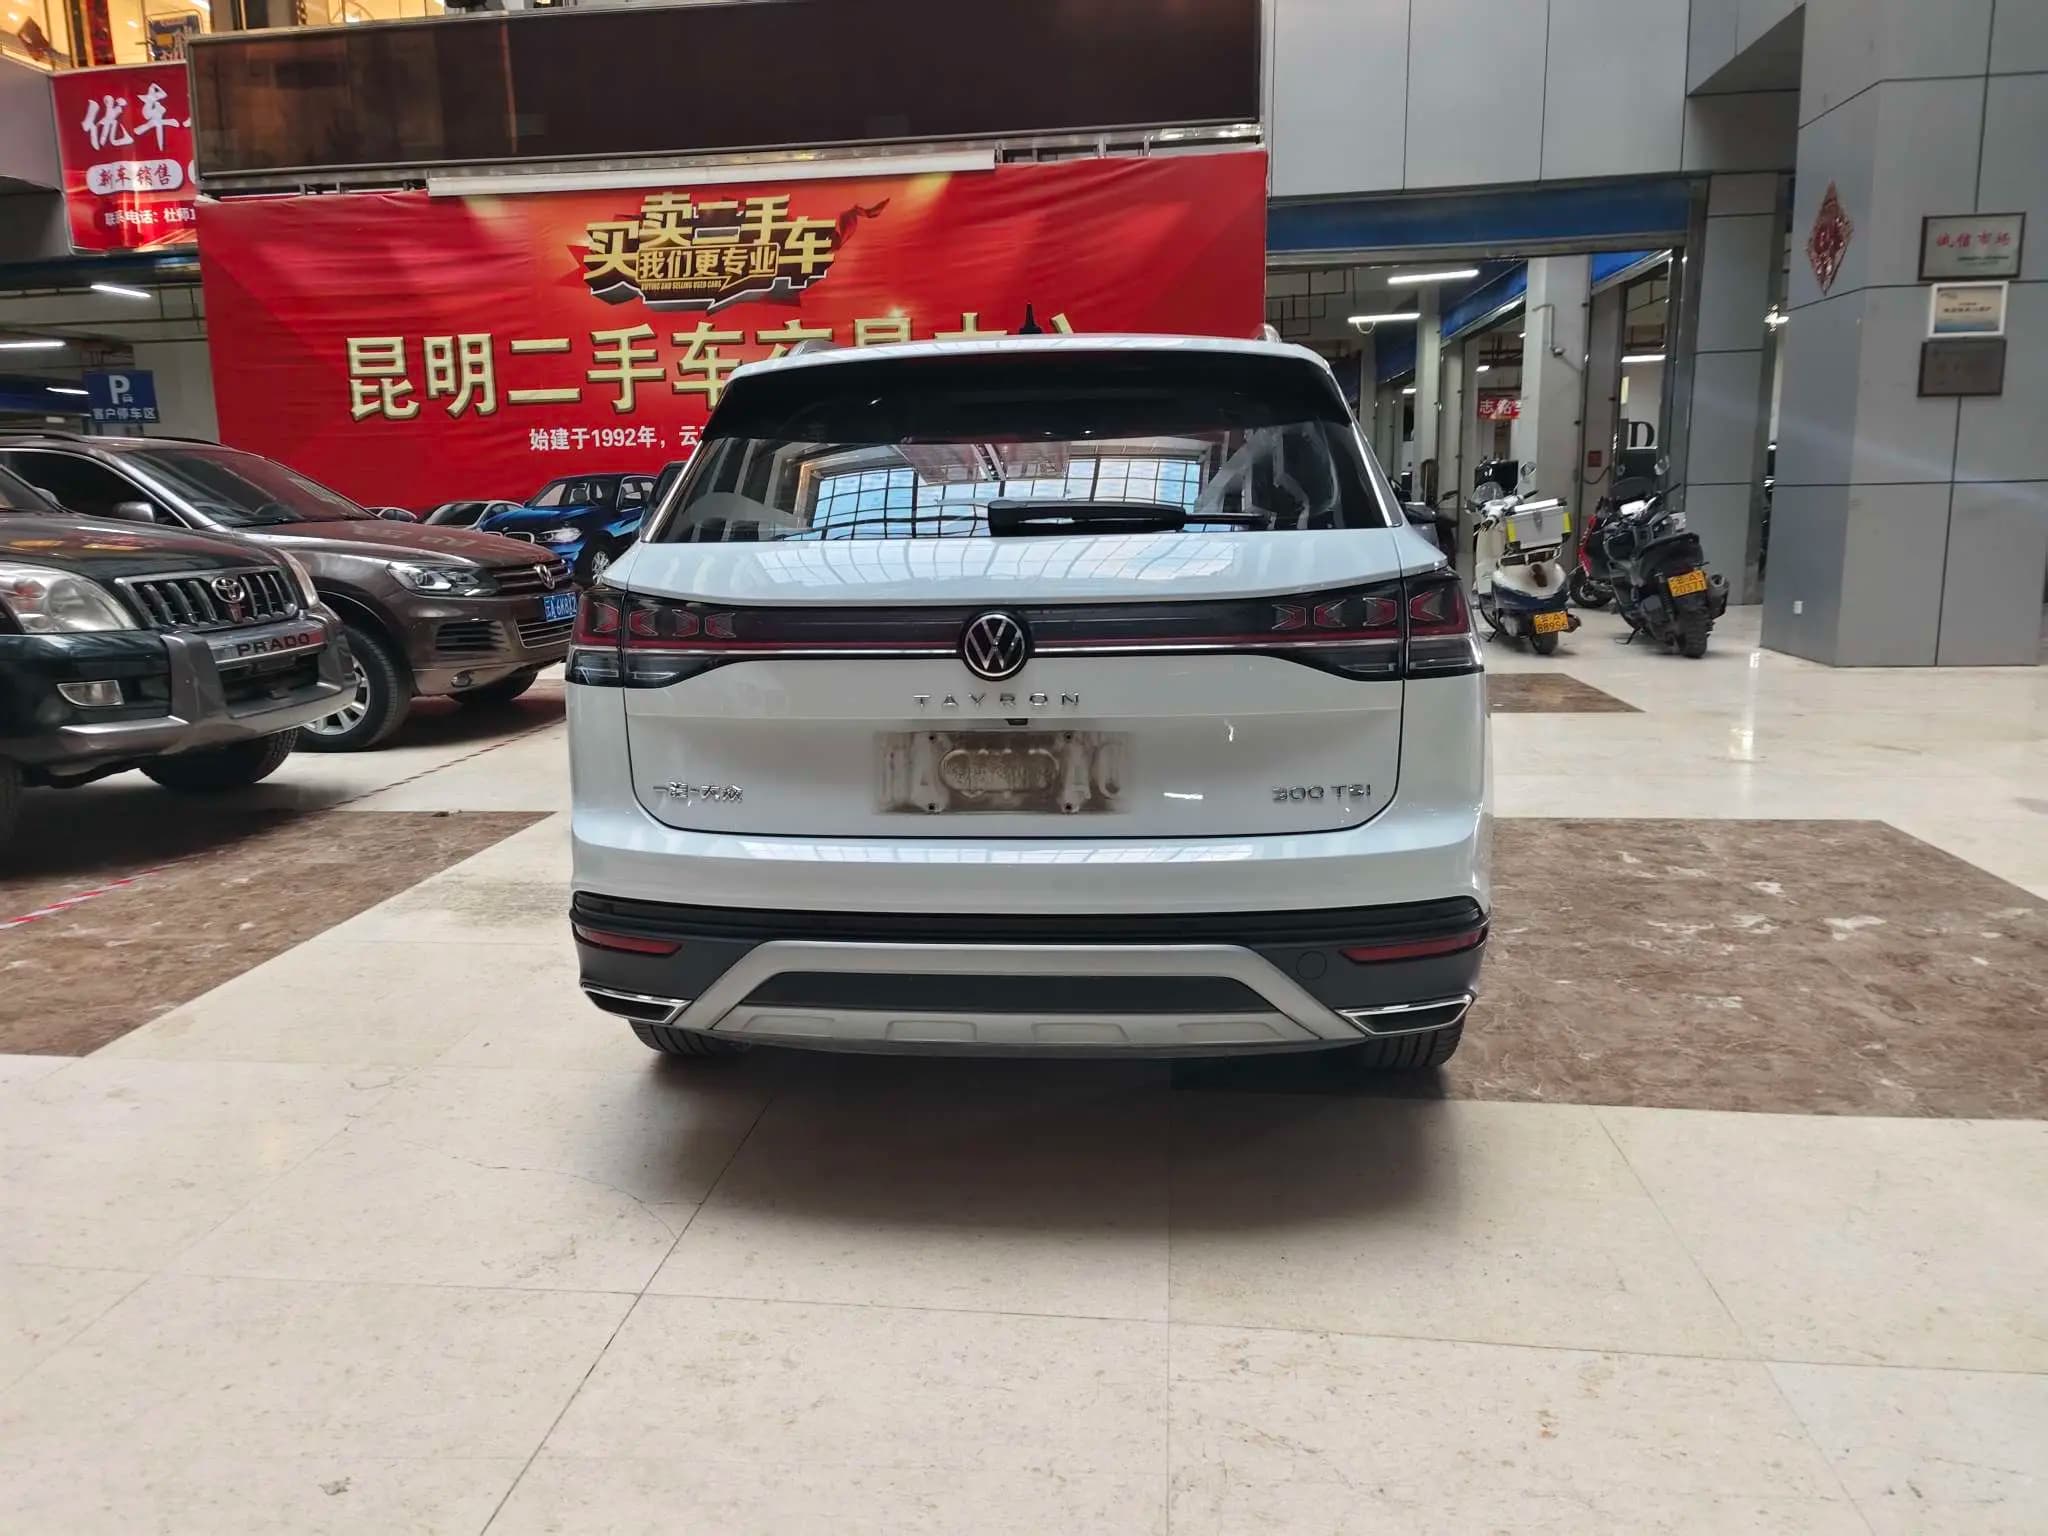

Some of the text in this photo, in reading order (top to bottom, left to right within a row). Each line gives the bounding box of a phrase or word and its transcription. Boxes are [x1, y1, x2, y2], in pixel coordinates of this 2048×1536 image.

[81, 83, 192, 152] 优车
[583, 192, 837, 279] 买卖二手车
[638, 245, 776, 279] 我们更专业
[108, 374, 130, 405] P
[529, 425, 708, 451] 始建于1992年，云
[236, 632, 311, 658] PRADO
[912, 692, 1081, 708] TAYRON
[1272, 785, 1325, 801] 300
